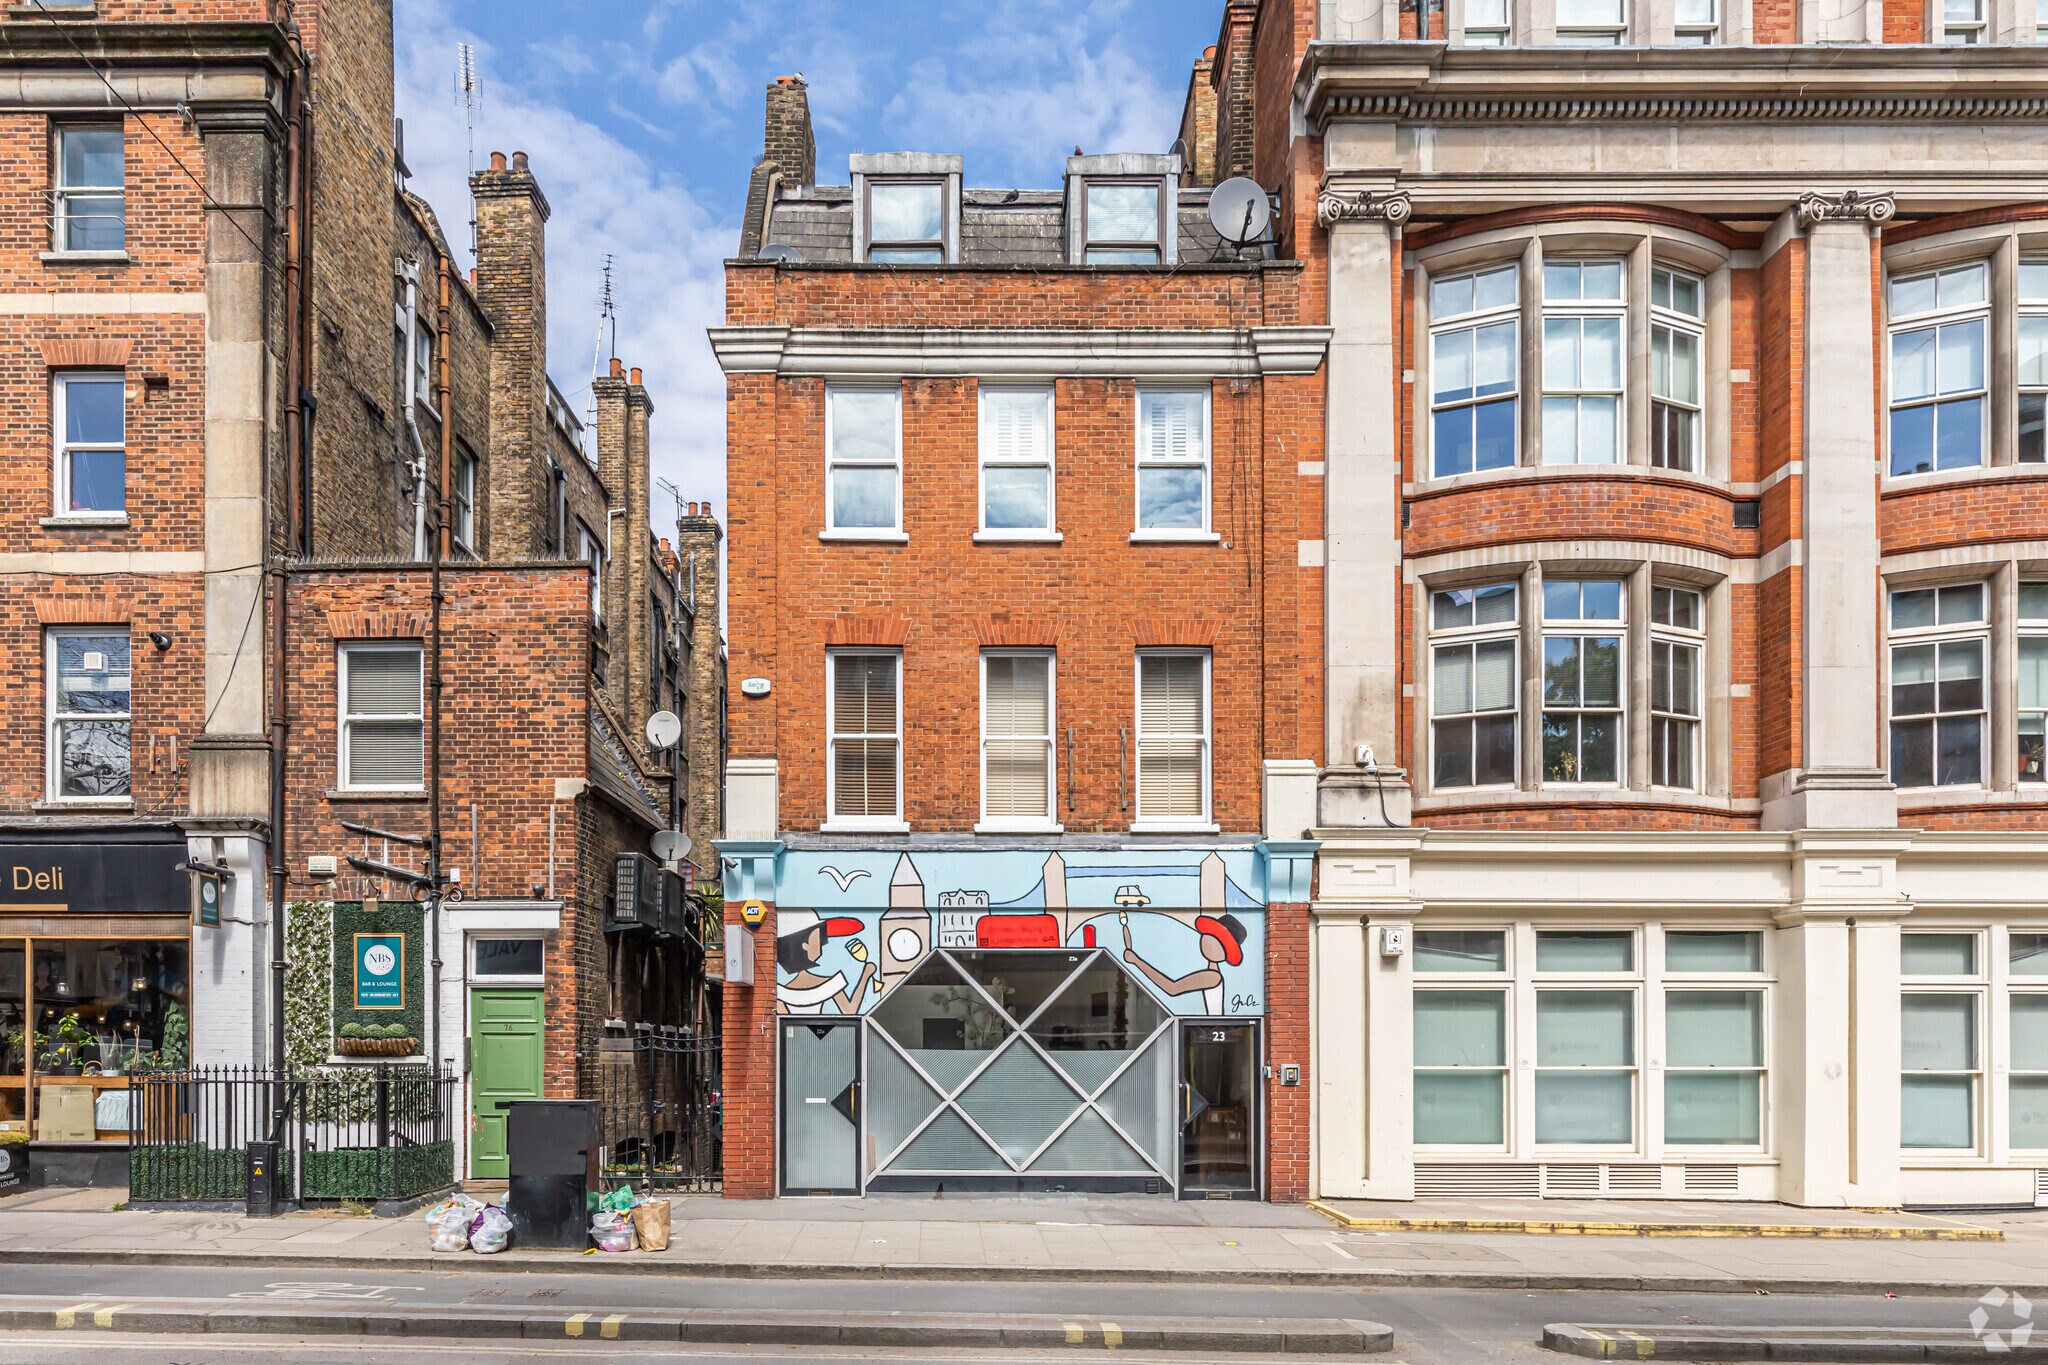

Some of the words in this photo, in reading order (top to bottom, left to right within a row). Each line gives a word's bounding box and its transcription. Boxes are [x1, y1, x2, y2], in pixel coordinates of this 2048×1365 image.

[13, 866, 63, 890] Deli
[747, 906, 759, 915] ADT
[369, 953, 392, 963] NBS
[1212, 1031, 1225, 1041] 23
